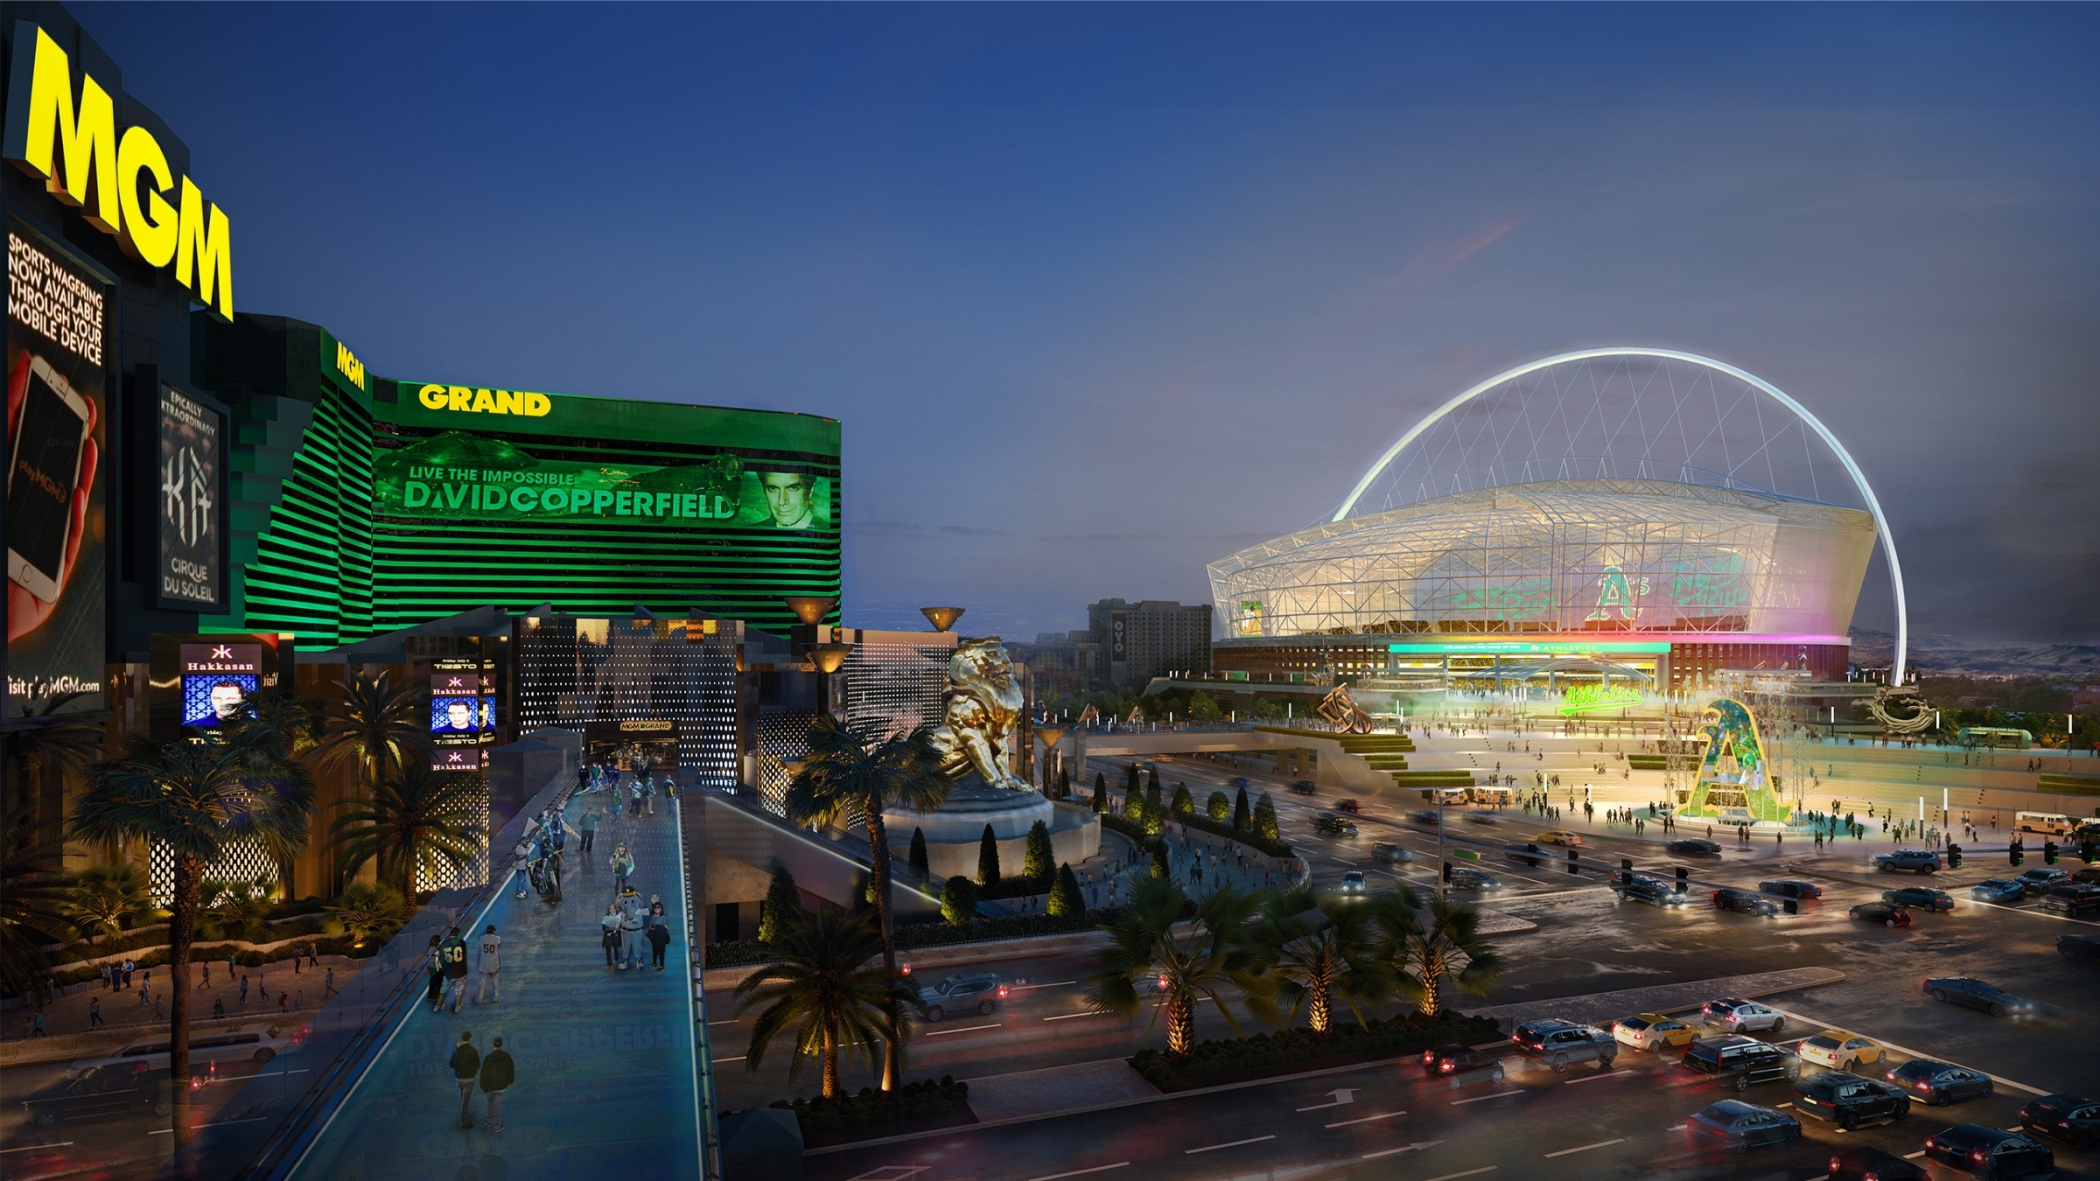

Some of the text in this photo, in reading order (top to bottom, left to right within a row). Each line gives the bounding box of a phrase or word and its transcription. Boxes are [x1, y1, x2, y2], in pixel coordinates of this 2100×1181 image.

[25, 26, 233, 322] MGM
[9, 233, 103, 310] SPORTS WAGERING
[8, 252, 103, 328] NOW AVAILABLE
[9, 274, 102, 347] THROUGH YOUR
[8, 295, 102, 366] MOBILE DEVICE
[337, 341, 364, 391] MGM
[171, 391, 202, 416] EPICALLY
[419, 384, 551, 417] GRAND
[409, 466, 574, 485] LIVE THE IMPOSSIBLE
[171, 557, 208, 583] CIRQUE
[164, 576, 215, 602] DU SOLEIL
[1114, 621, 1124, 652] OYO
[187, 662, 254, 671] Hakkasan
[1558, 684, 1640, 707] Athletics
[443, 946, 463, 963] 50
[483, 944, 496, 954] 50
